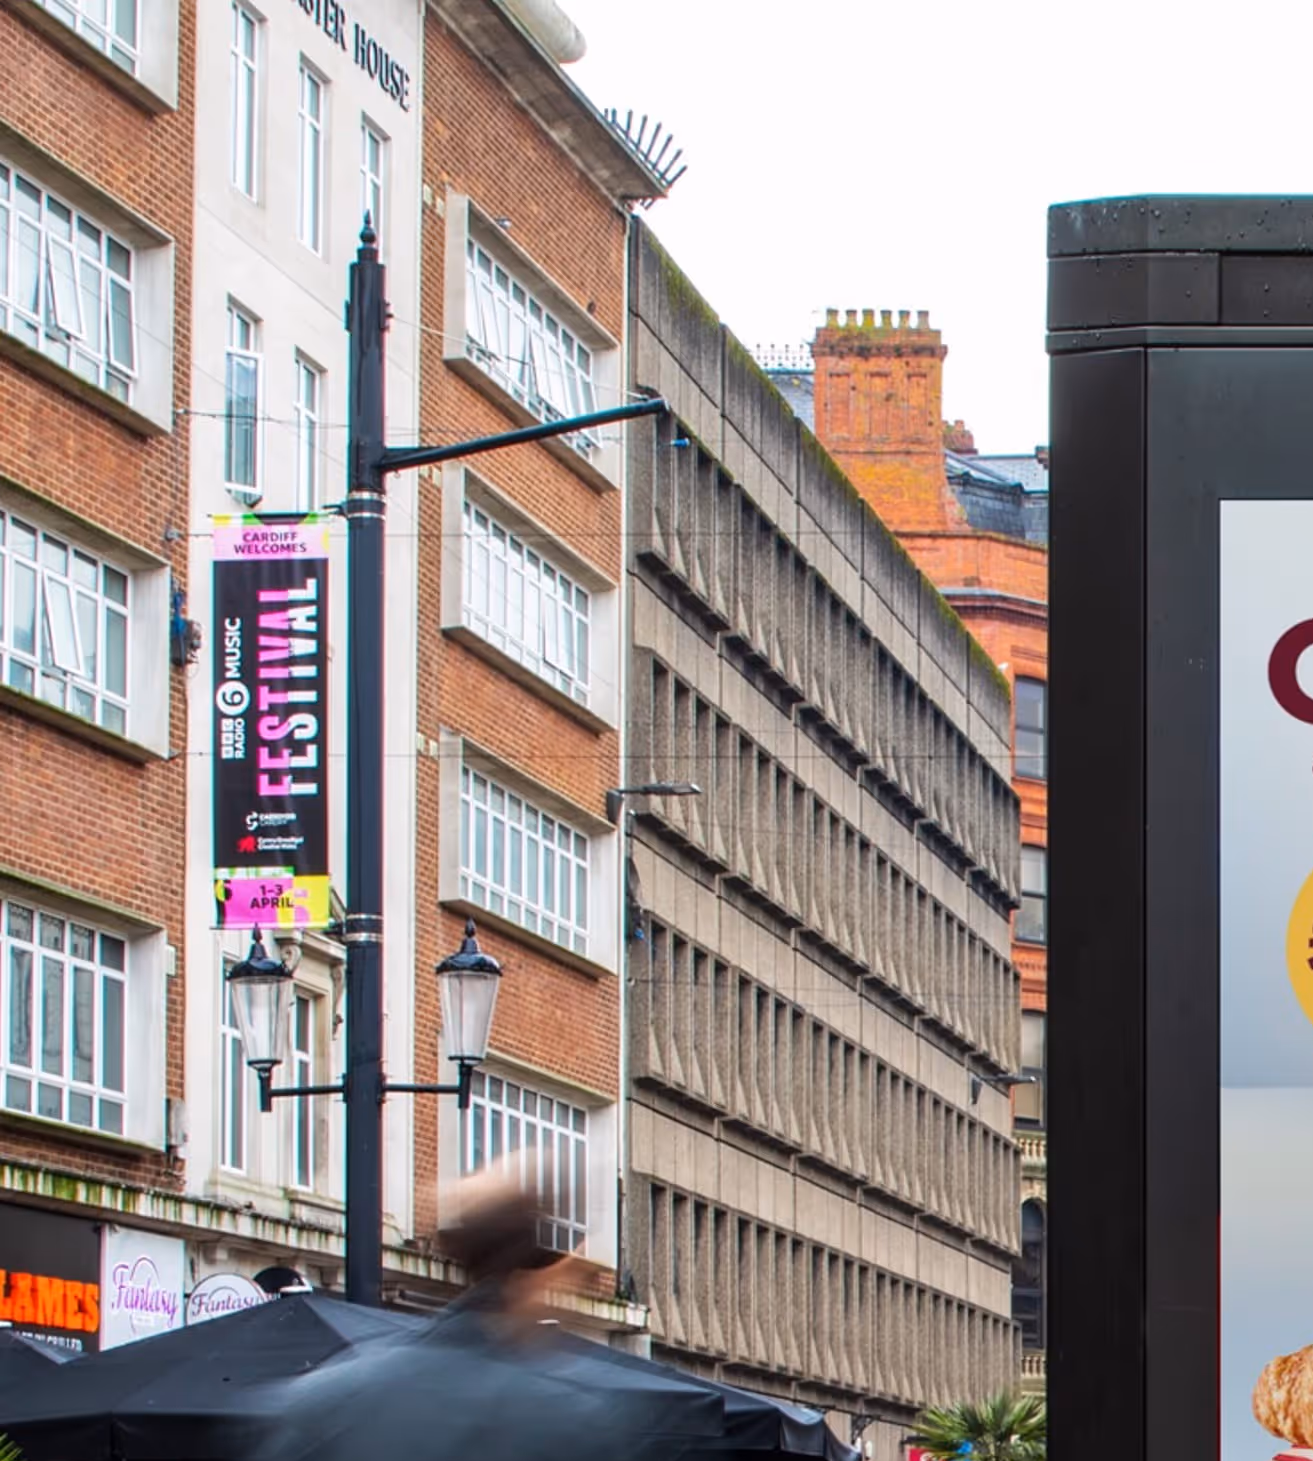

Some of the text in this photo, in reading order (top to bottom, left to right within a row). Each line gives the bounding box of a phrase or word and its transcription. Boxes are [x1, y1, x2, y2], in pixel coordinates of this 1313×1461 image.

[292, 0, 410, 112] TER HOUSE
[233, 543, 308, 555] WELCOMES
[243, 531, 299, 543] CARDIFF
[225, 617, 241, 679] MUSIC
[258, 577, 318, 796] FESTIVAL
[235, 718, 246, 759] RADIO
[250, 897, 294, 909] APRIL
[260, 884, 283, 896] 1-3
[112, 1264, 178, 1327] Fantasy
